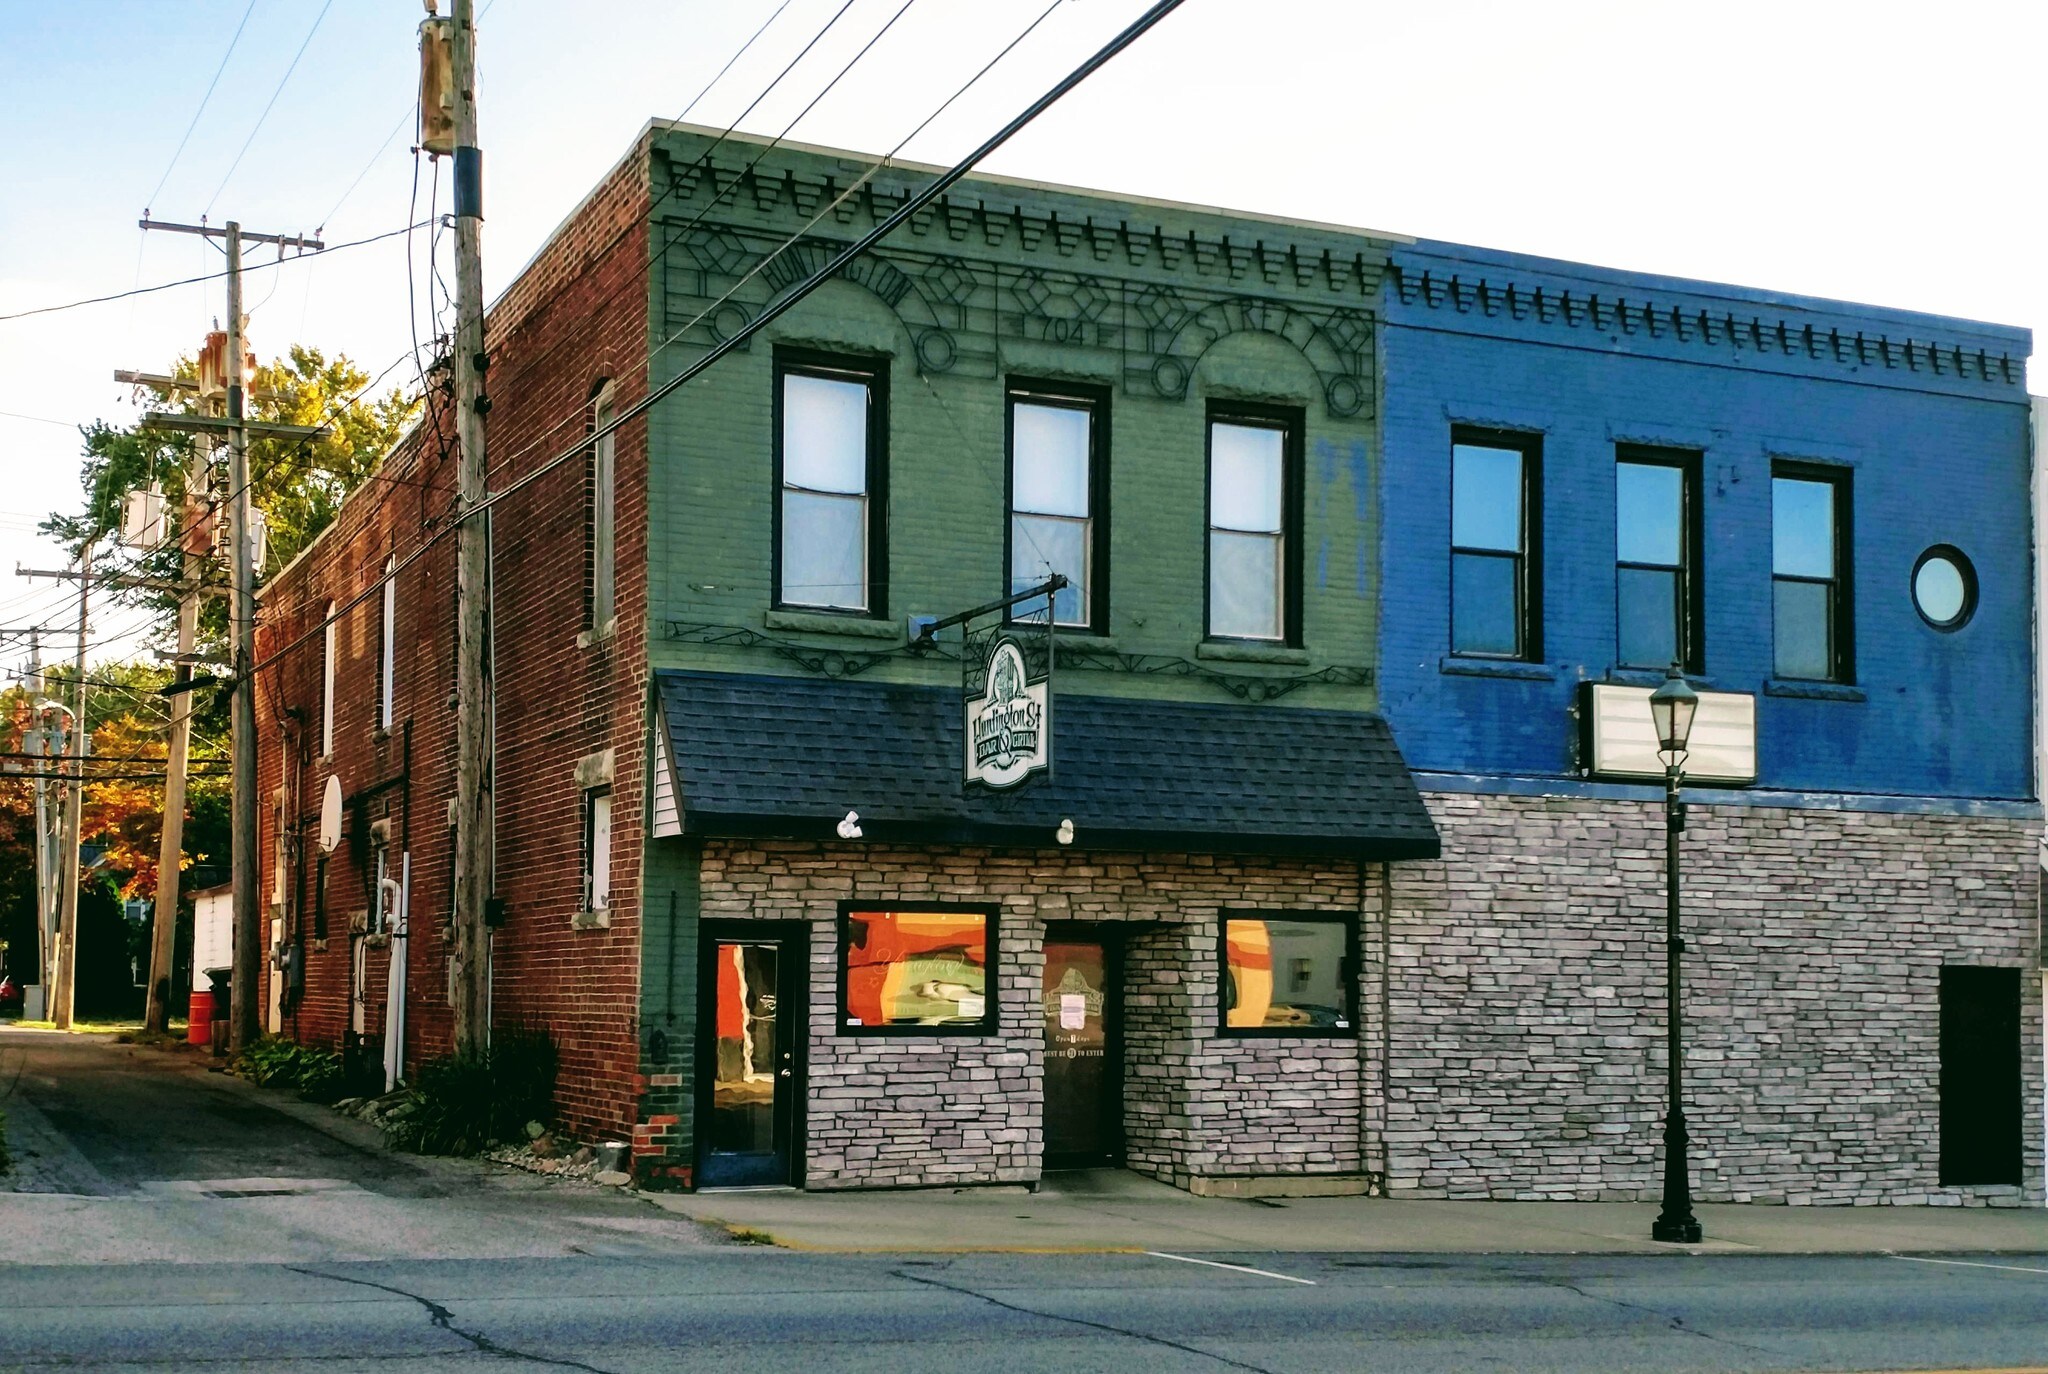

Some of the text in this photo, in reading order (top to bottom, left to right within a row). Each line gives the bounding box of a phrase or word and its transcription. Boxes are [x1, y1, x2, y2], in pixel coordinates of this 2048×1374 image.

[1037, 317, 1084, 345] 704
[973, 704, 1026, 743] Huntington
[979, 725, 1035, 759] BAR & GRILL
